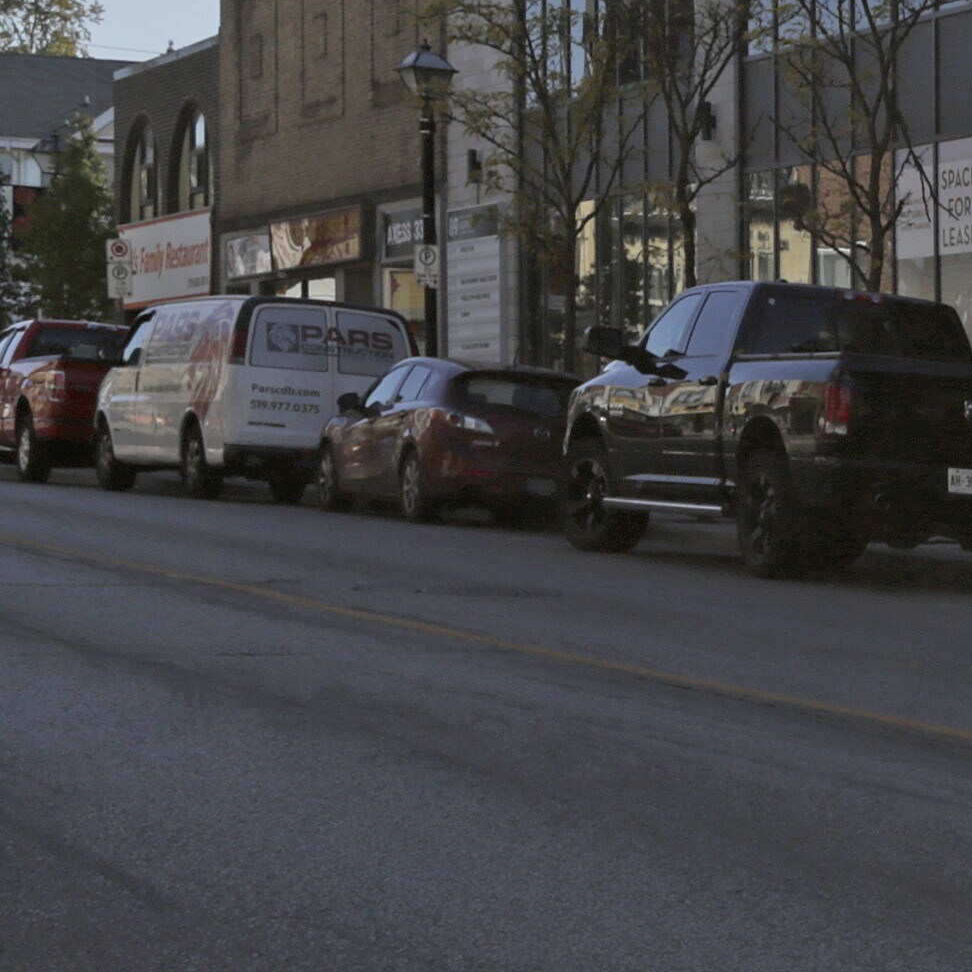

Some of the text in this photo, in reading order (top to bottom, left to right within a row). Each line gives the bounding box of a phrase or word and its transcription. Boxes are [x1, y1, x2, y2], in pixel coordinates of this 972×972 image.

[948, 196, 972, 218] FOR
[387, 220, 412, 245] AXESS
[140, 242, 164, 278] Family
[166, 238, 210, 270] Restaurant
[301, 324, 394, 351] PARS
[251, 383, 321, 398] Parscdb.com
[249, 399, 321, 415] 519.977.0375
